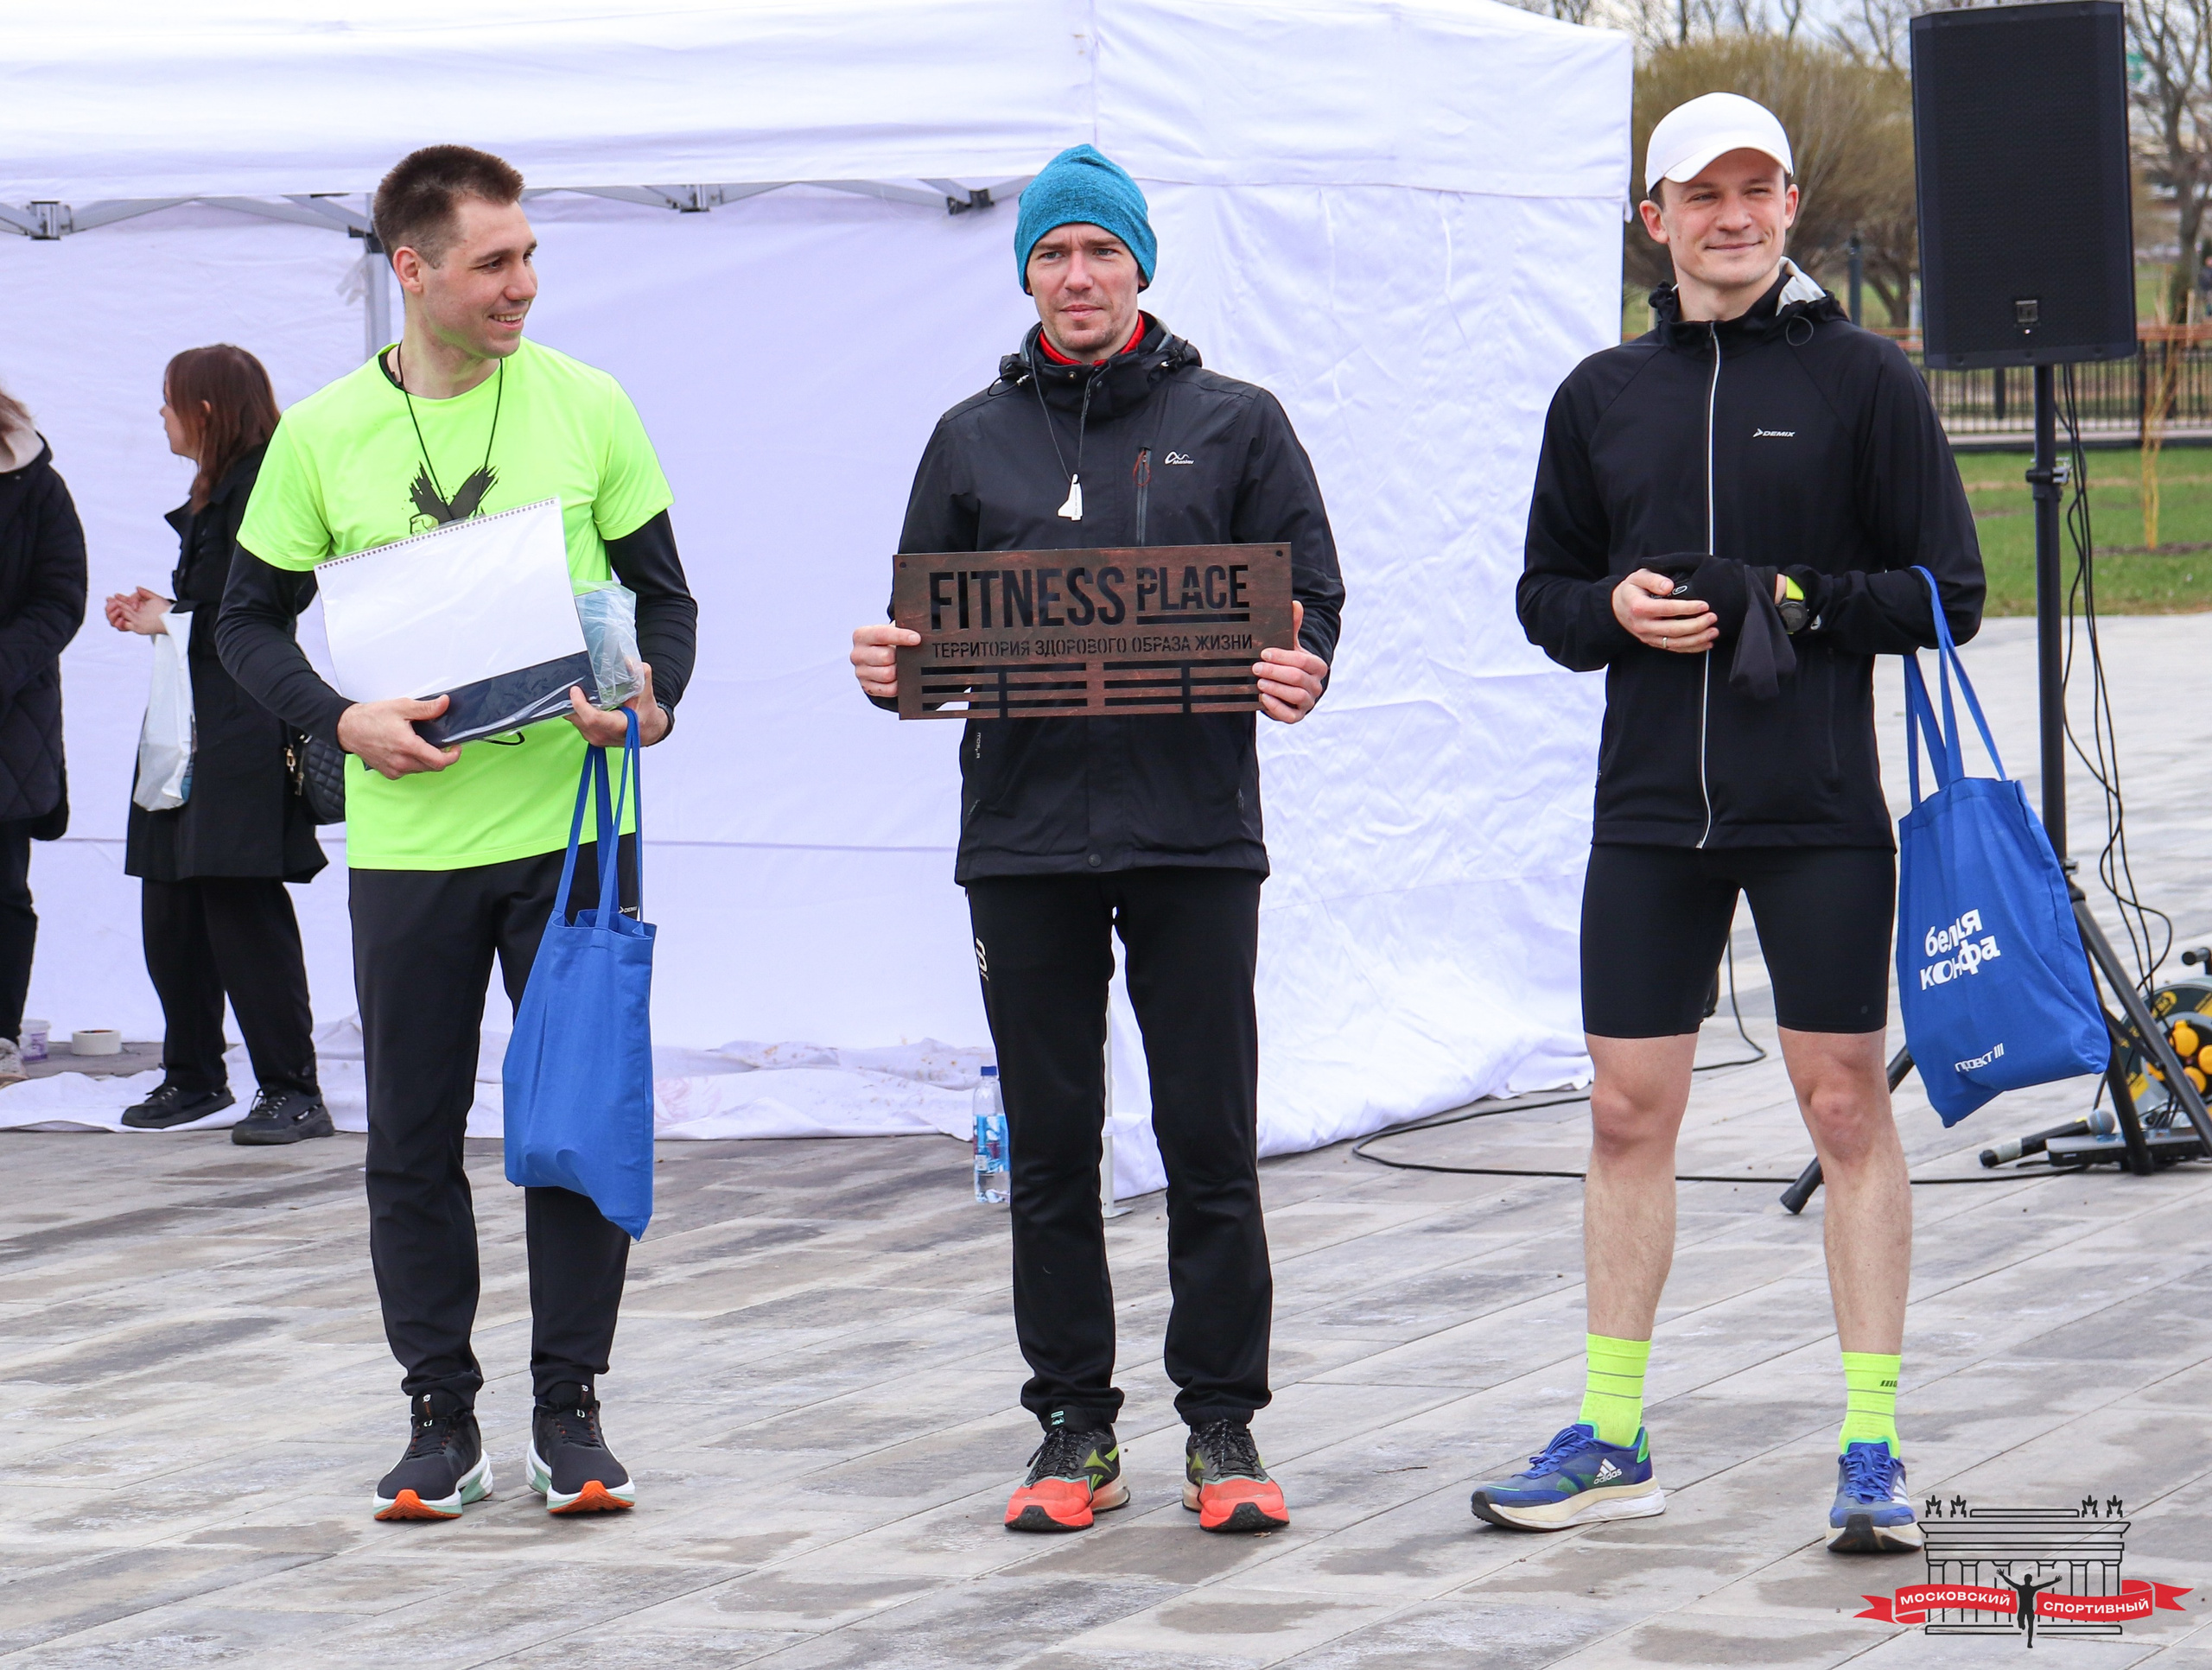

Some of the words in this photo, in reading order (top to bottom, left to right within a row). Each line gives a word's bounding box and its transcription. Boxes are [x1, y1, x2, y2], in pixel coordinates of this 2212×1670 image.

[929, 567, 1126, 630] FITNESS
[1136, 564, 1250, 611] PLACE
[931, 641, 1030, 658] ТЕРРИТОРИЯ
[1035, 637, 1127, 657] ЗДОРОВОГО
[1132, 636, 1191, 653] ОБРАЗА
[1195, 633, 1253, 651] ЖИЗНИ
[1593, 1468, 1623, 1484] adidas
